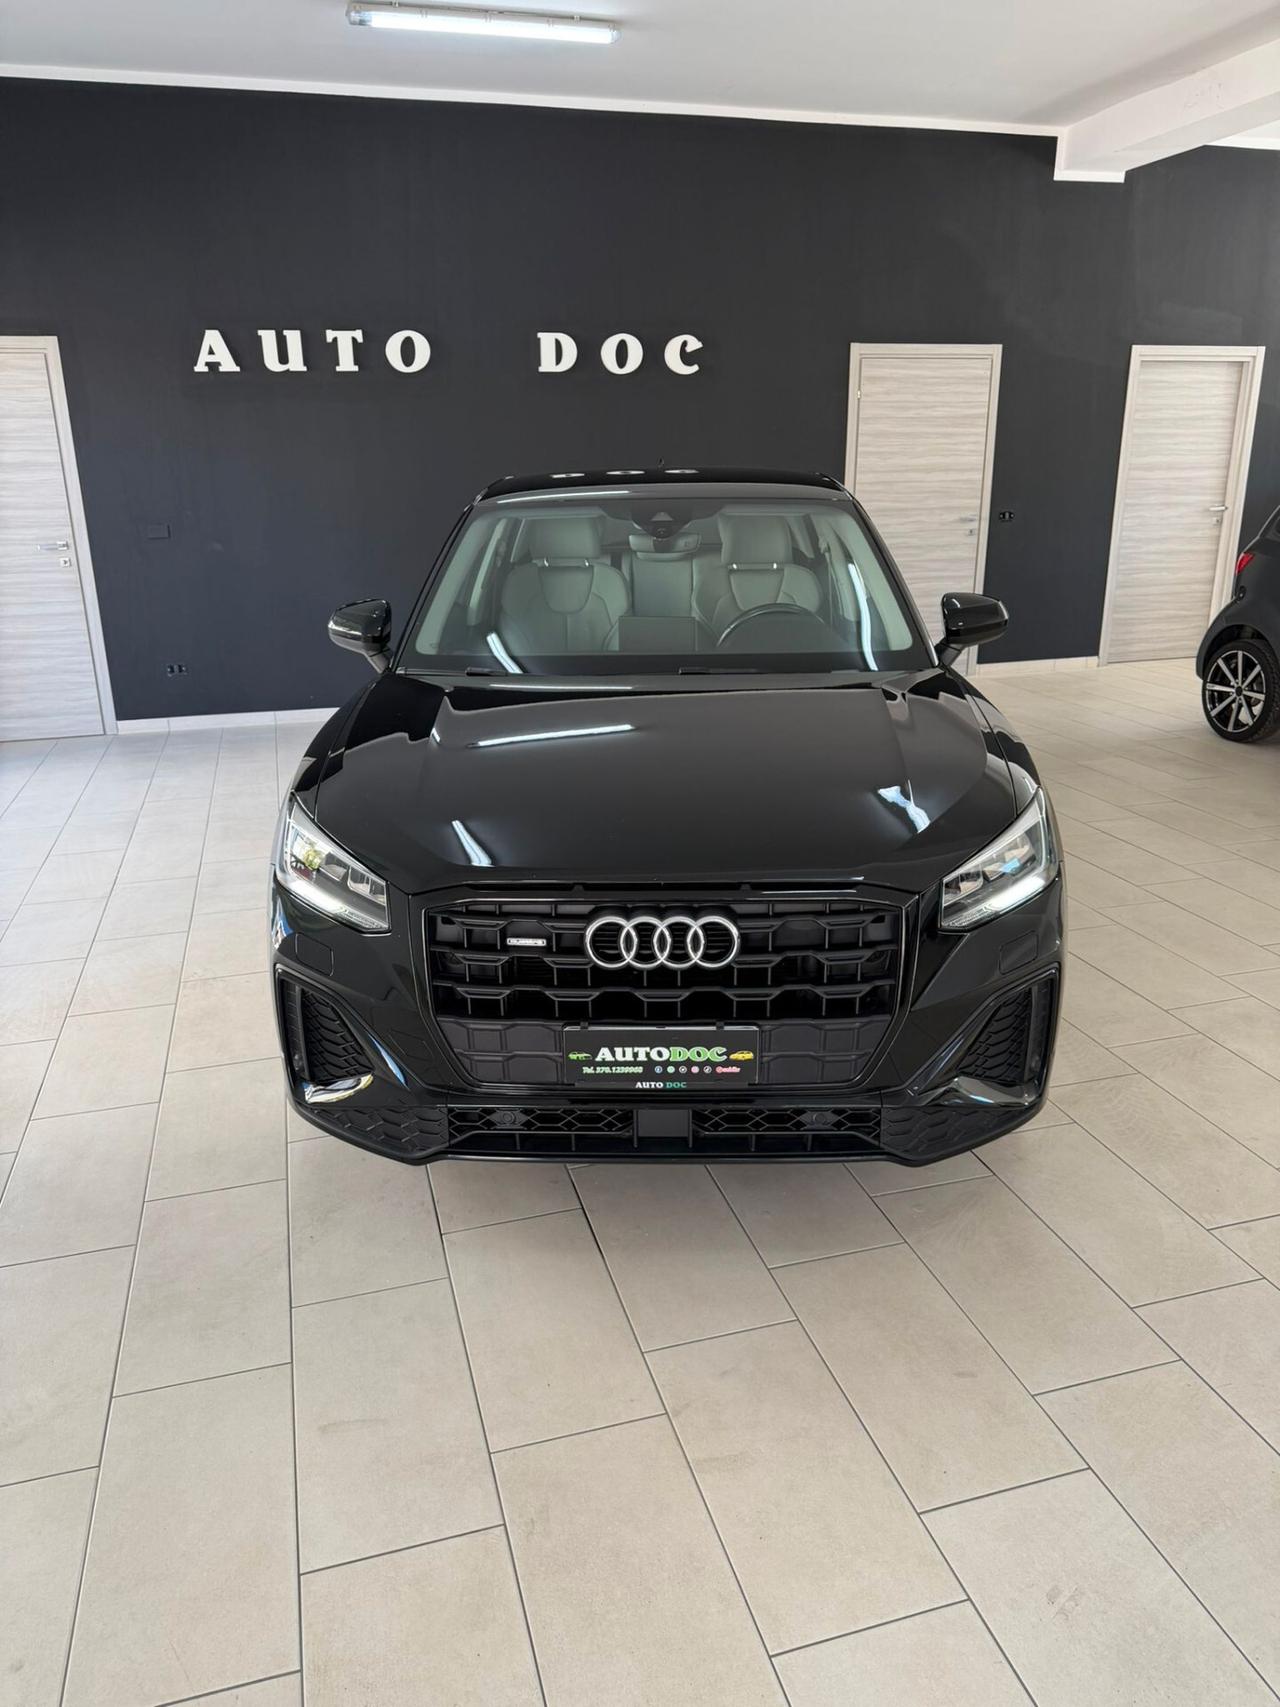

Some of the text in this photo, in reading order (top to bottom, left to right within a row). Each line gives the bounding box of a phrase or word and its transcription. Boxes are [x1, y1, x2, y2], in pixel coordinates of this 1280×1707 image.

[194, 329, 704, 375] AUTO DOC
[595, 1046, 728, 1062] AUTODOC
[635, 1081, 687, 1089] AUTO DOC
